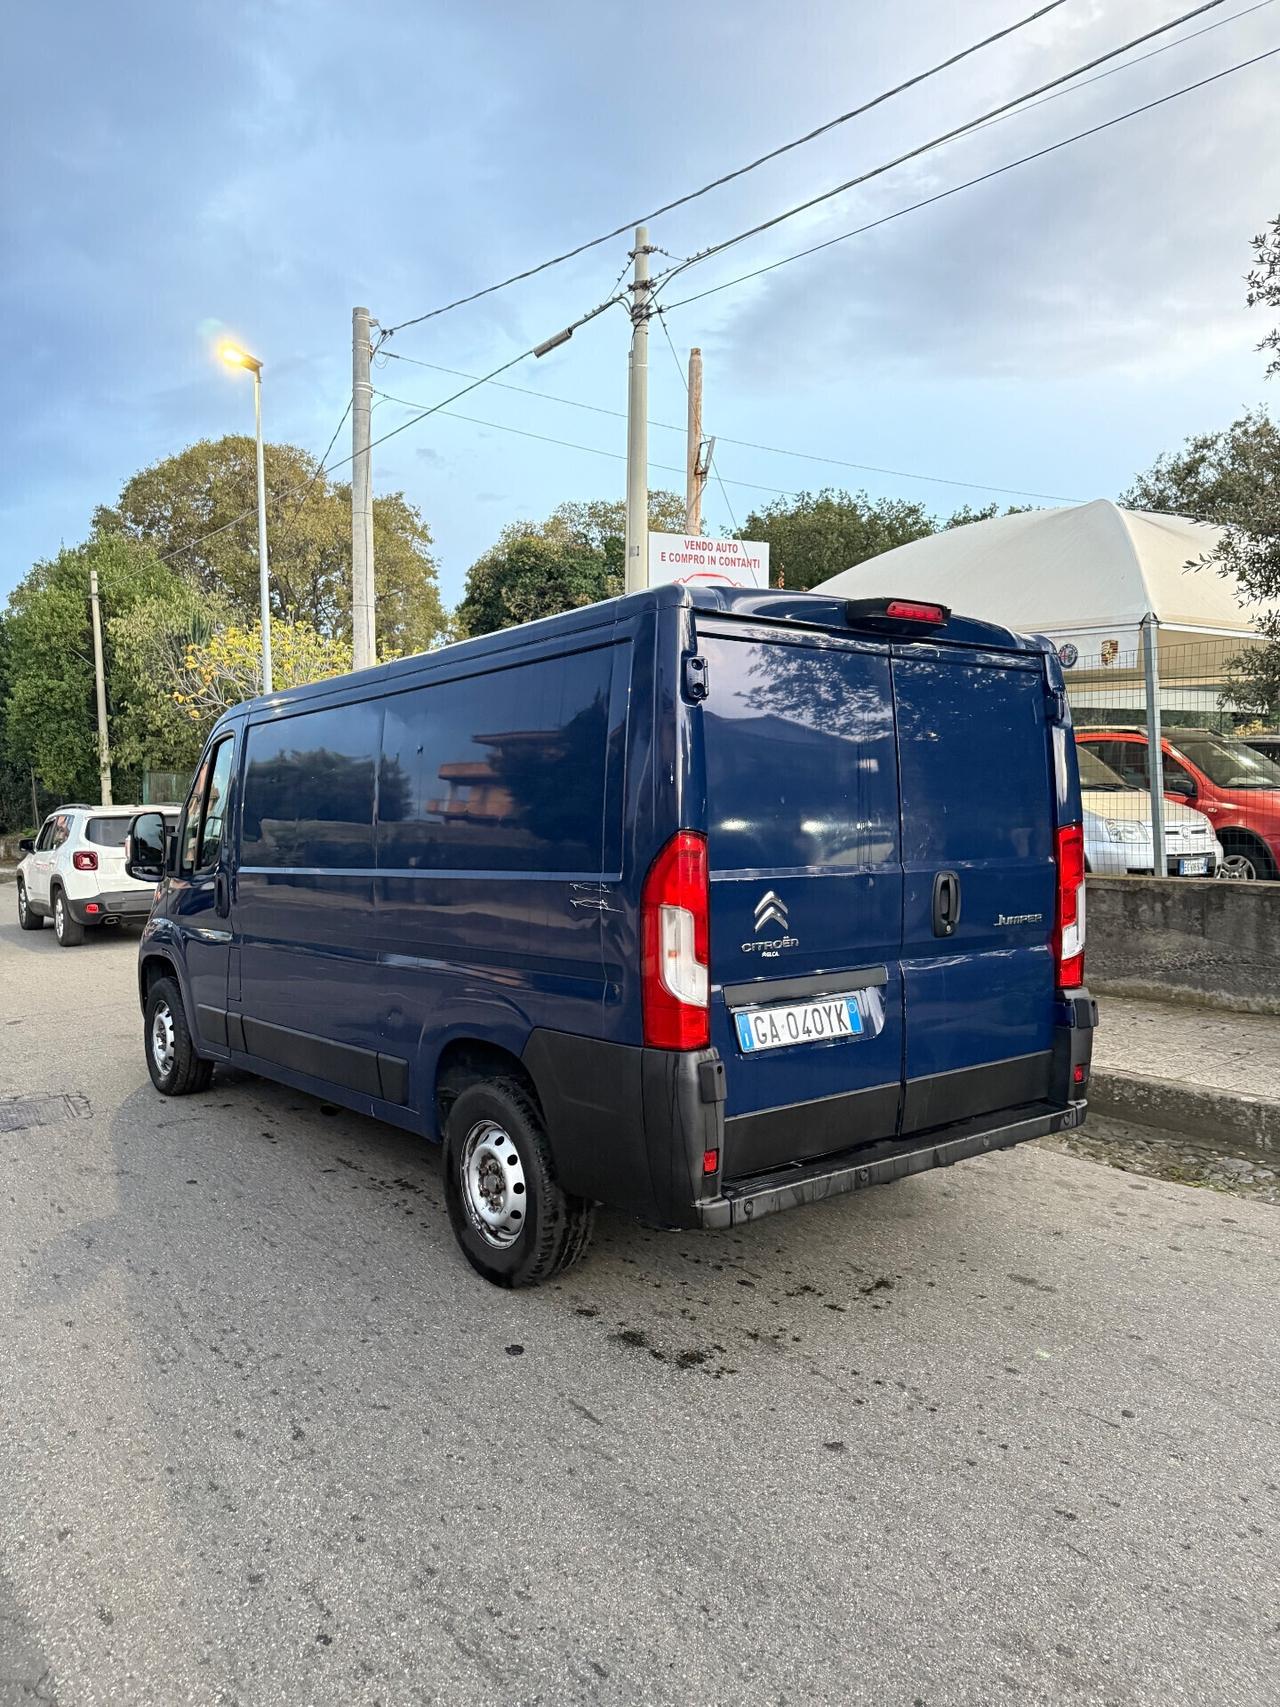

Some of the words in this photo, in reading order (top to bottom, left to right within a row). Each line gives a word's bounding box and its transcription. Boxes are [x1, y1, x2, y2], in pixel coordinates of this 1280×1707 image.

[684, 540, 713, 551] VENDO
[716, 543, 738, 553] AUTO
[661, 552, 666, 562] E
[669, 552, 705, 565] COMPRO
[707, 555, 716, 565] IN
[718, 557, 760, 569] CONTANTI
